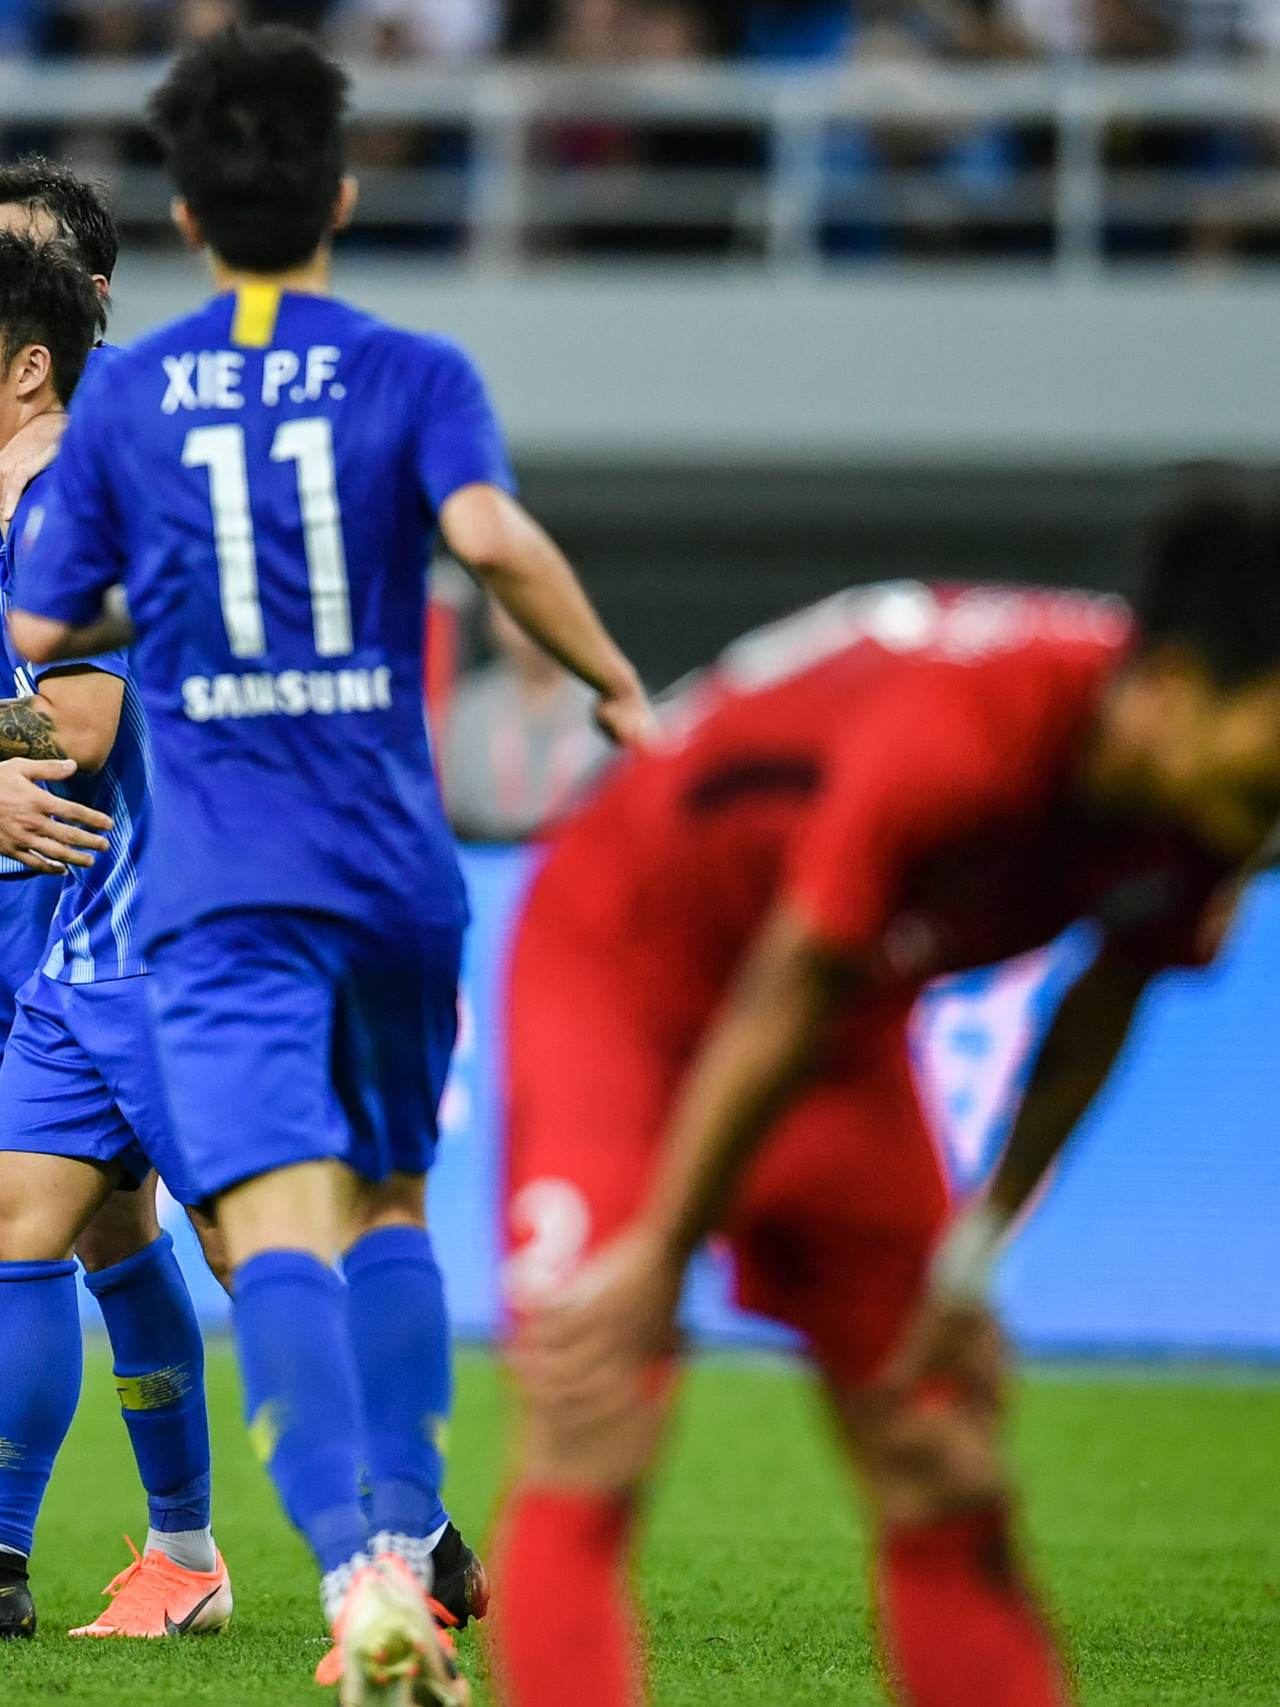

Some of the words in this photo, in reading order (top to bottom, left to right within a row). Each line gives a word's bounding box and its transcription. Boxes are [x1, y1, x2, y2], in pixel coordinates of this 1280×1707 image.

[160, 350, 246, 415] XIE
[261, 345, 347, 407] P.F.
[181, 416, 352, 659] 11
